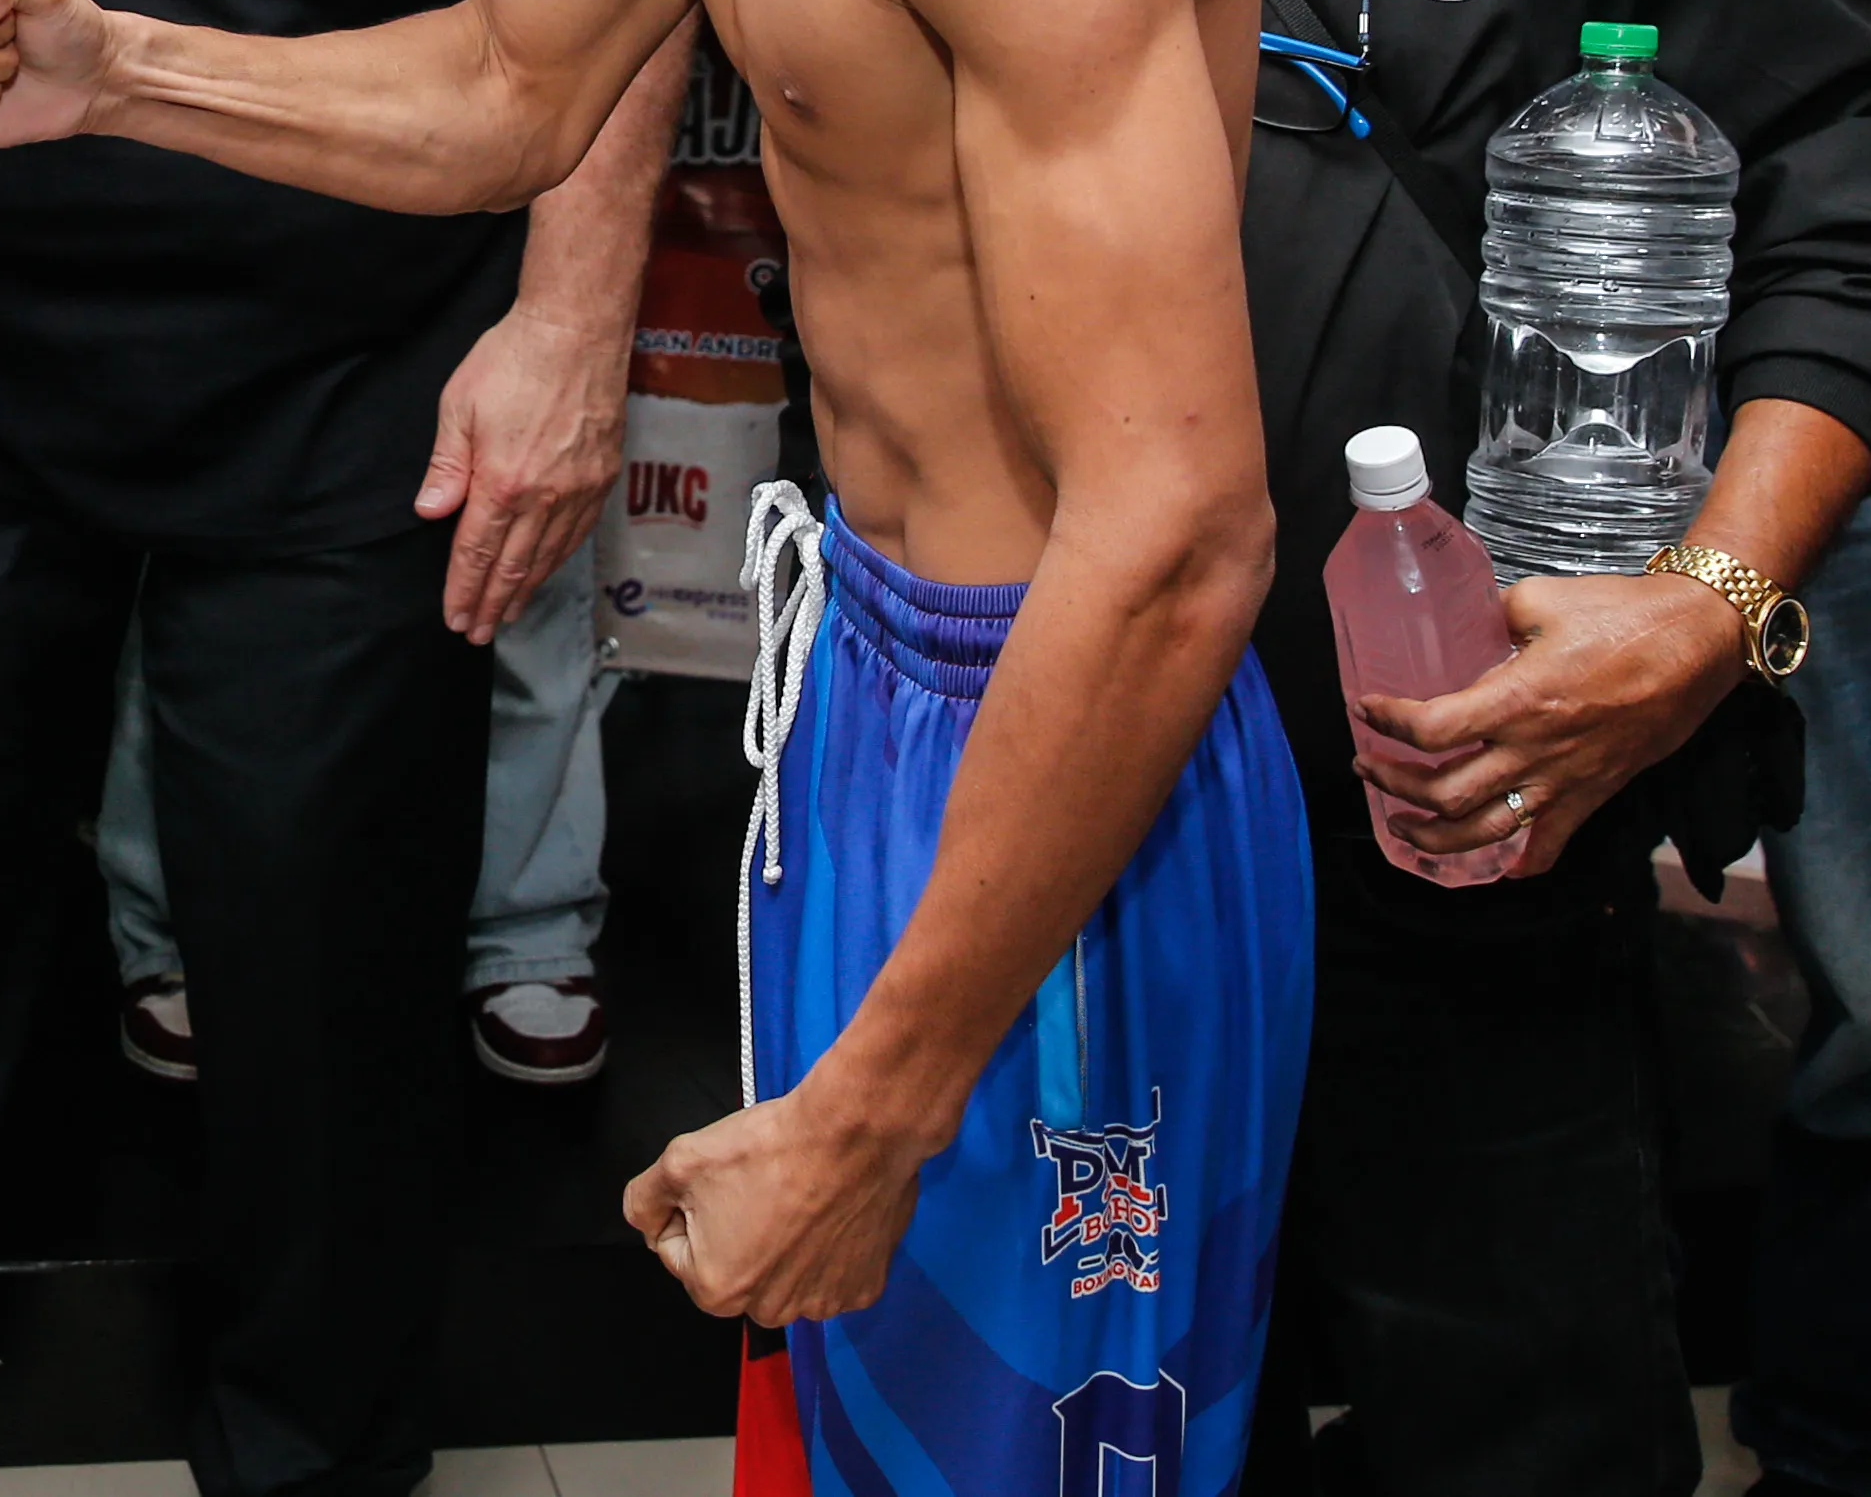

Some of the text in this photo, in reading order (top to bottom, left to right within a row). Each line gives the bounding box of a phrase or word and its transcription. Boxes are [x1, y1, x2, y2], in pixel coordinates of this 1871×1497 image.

[636, 328, 782, 362] SAN ANDR
[627, 461, 709, 523] UKC
